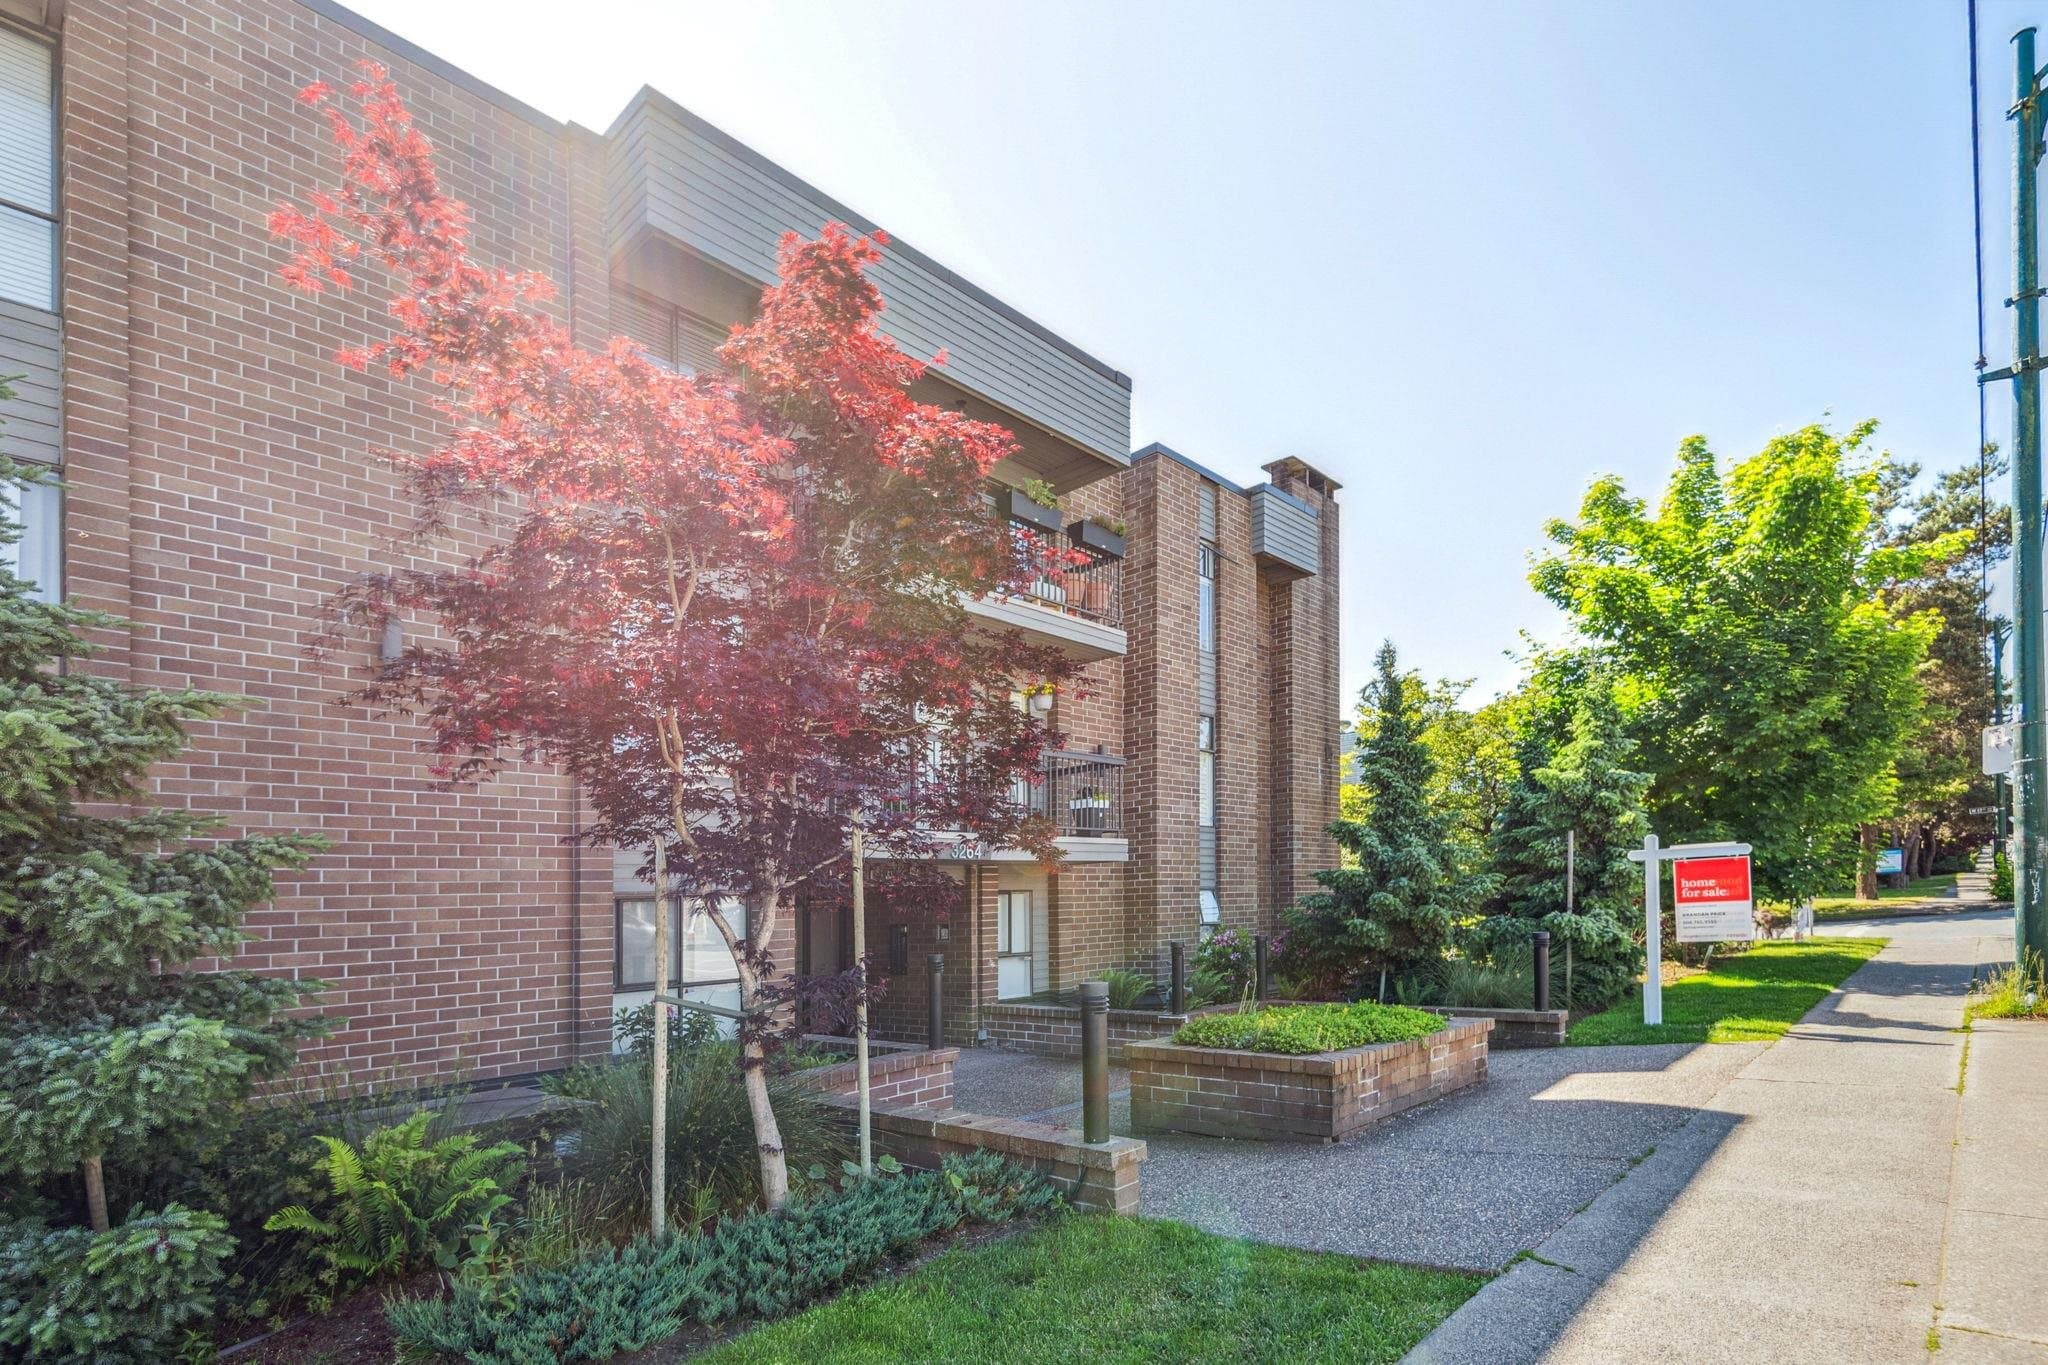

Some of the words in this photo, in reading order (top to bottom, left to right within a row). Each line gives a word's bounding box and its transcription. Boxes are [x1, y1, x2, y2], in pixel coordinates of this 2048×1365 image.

[952, 843, 982, 859] 3264
[1681, 878, 1716, 888] home
[1681, 888, 1701, 898] for
